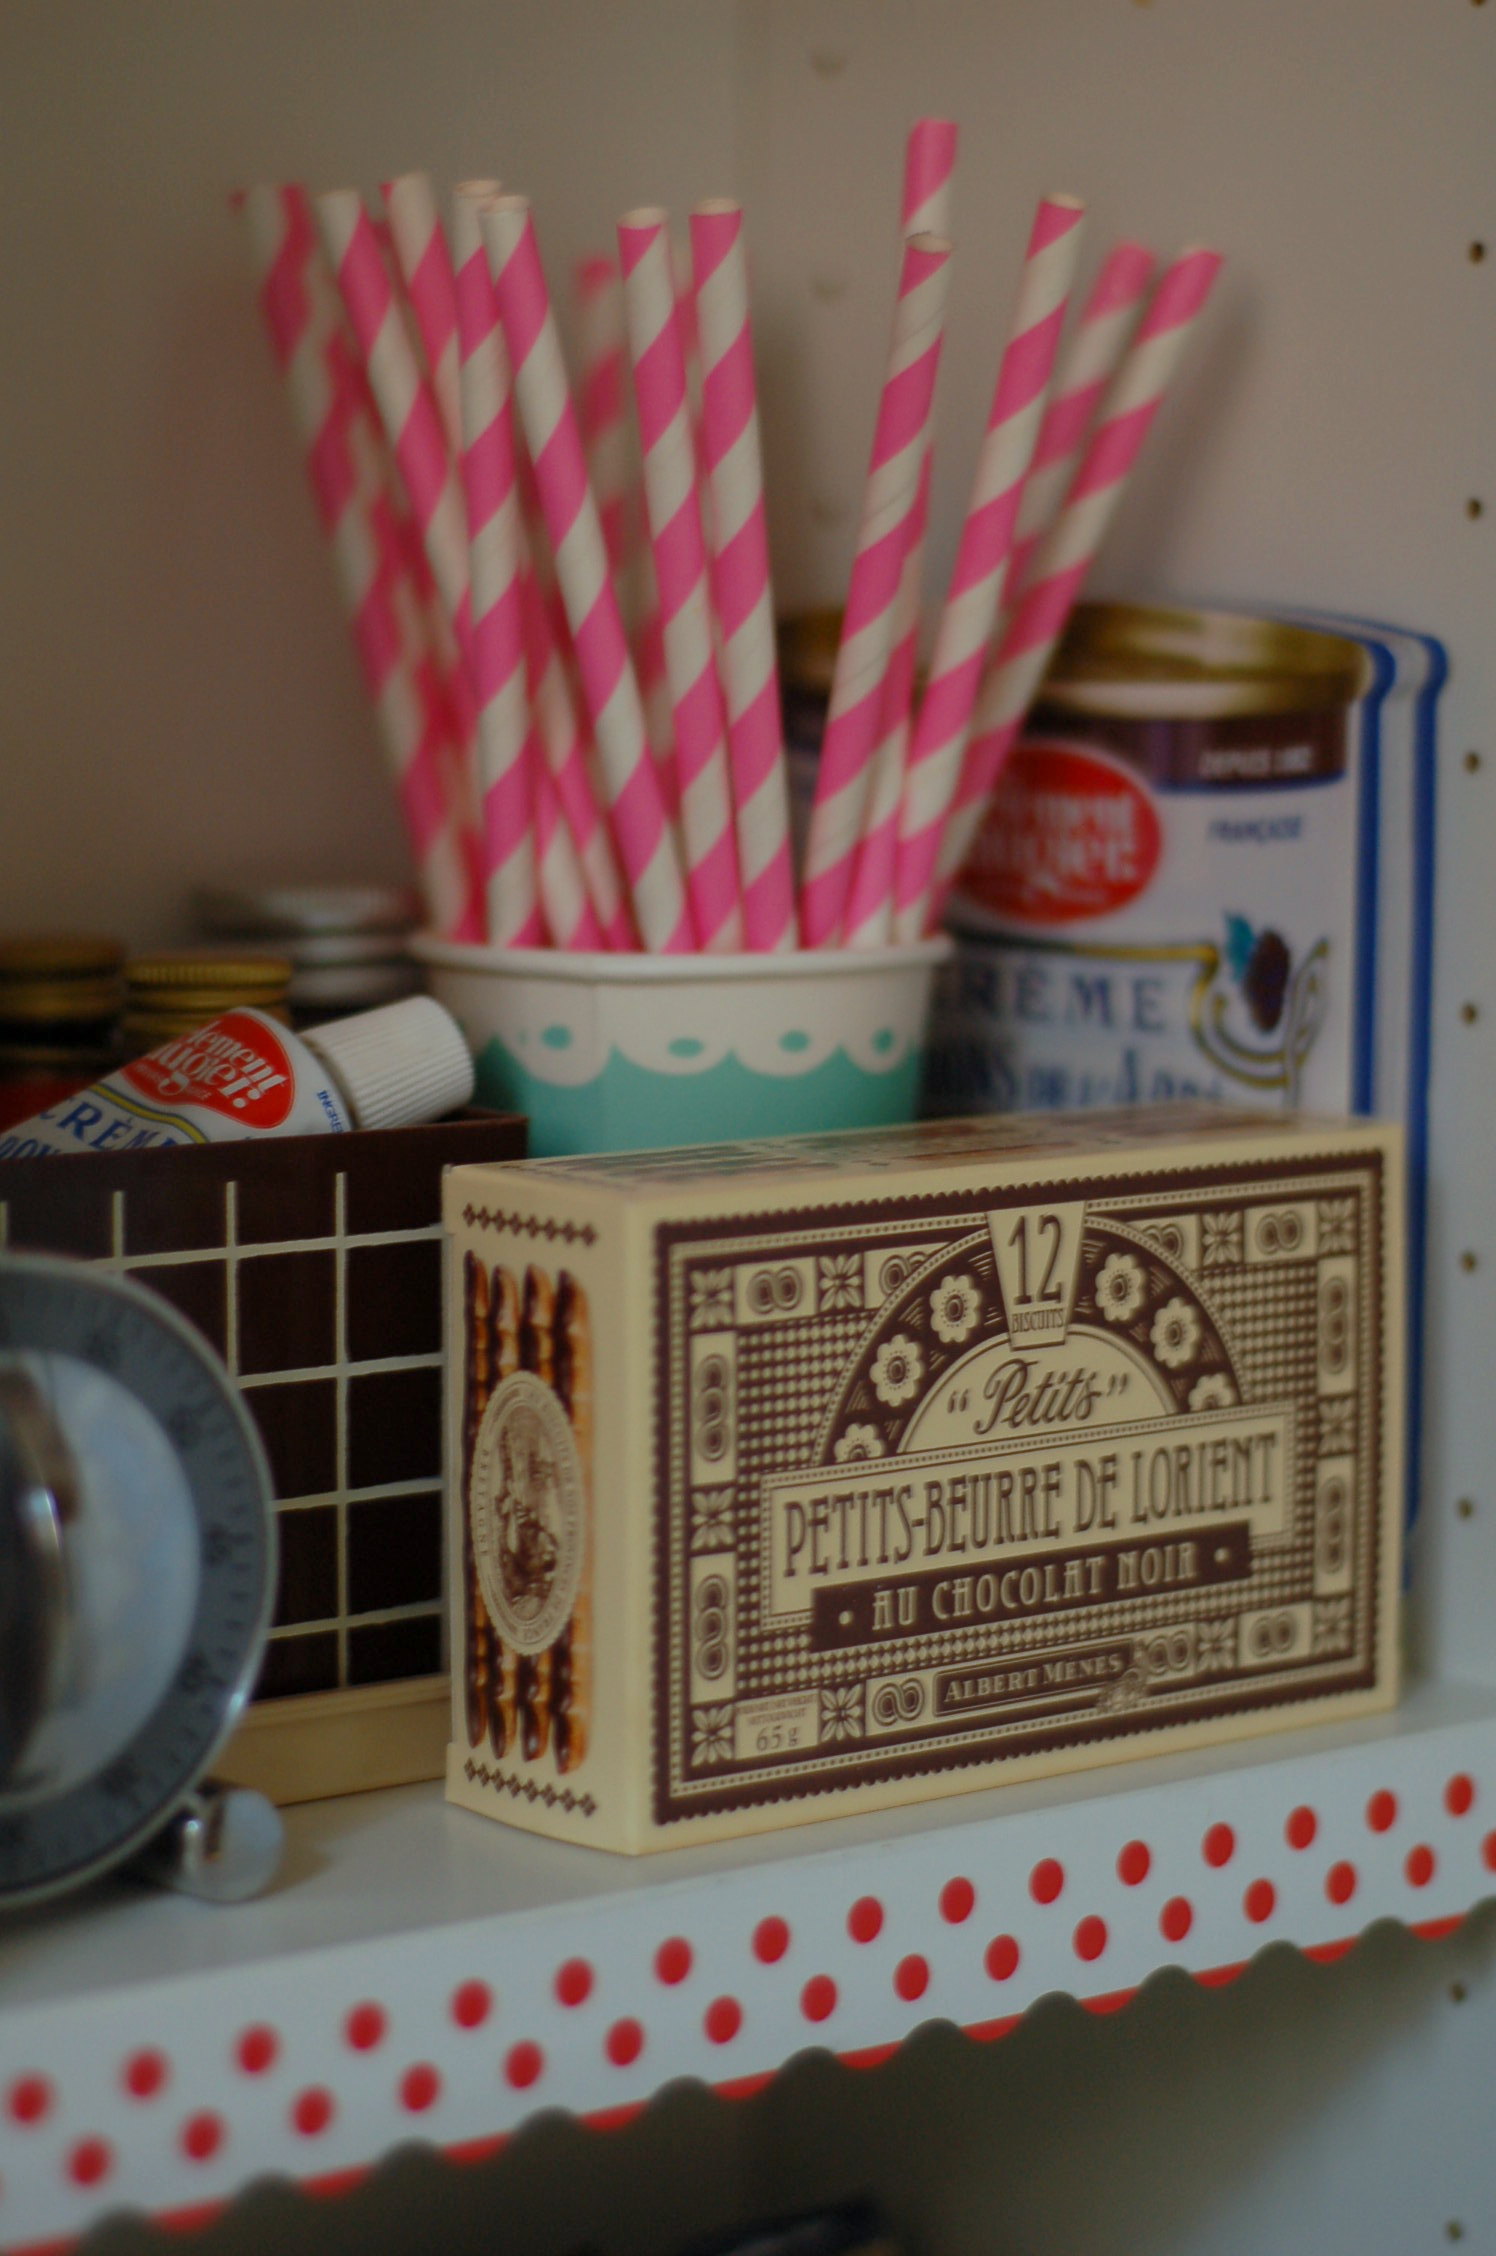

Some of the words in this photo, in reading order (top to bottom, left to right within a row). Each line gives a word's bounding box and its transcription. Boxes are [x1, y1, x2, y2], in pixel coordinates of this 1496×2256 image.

[1007, 1213, 1063, 1306] 12
[1011, 1308, 1064, 1334] BISCUITS
[783, 1460, 1061, 1578] PETITS-BEURRE
[1075, 1455, 1117, 1535] DE
[1130, 1432, 1277, 1526] LORIENT
[872, 1588, 918, 1631] AU
[931, 1555, 1102, 1622] CHOCOLAT
[1117, 1541, 1198, 1591] NOIR
[944, 1668, 1038, 1703] ALBERT
[755, 1724, 783, 1751] 65
[787, 1726, 802, 1747] g
